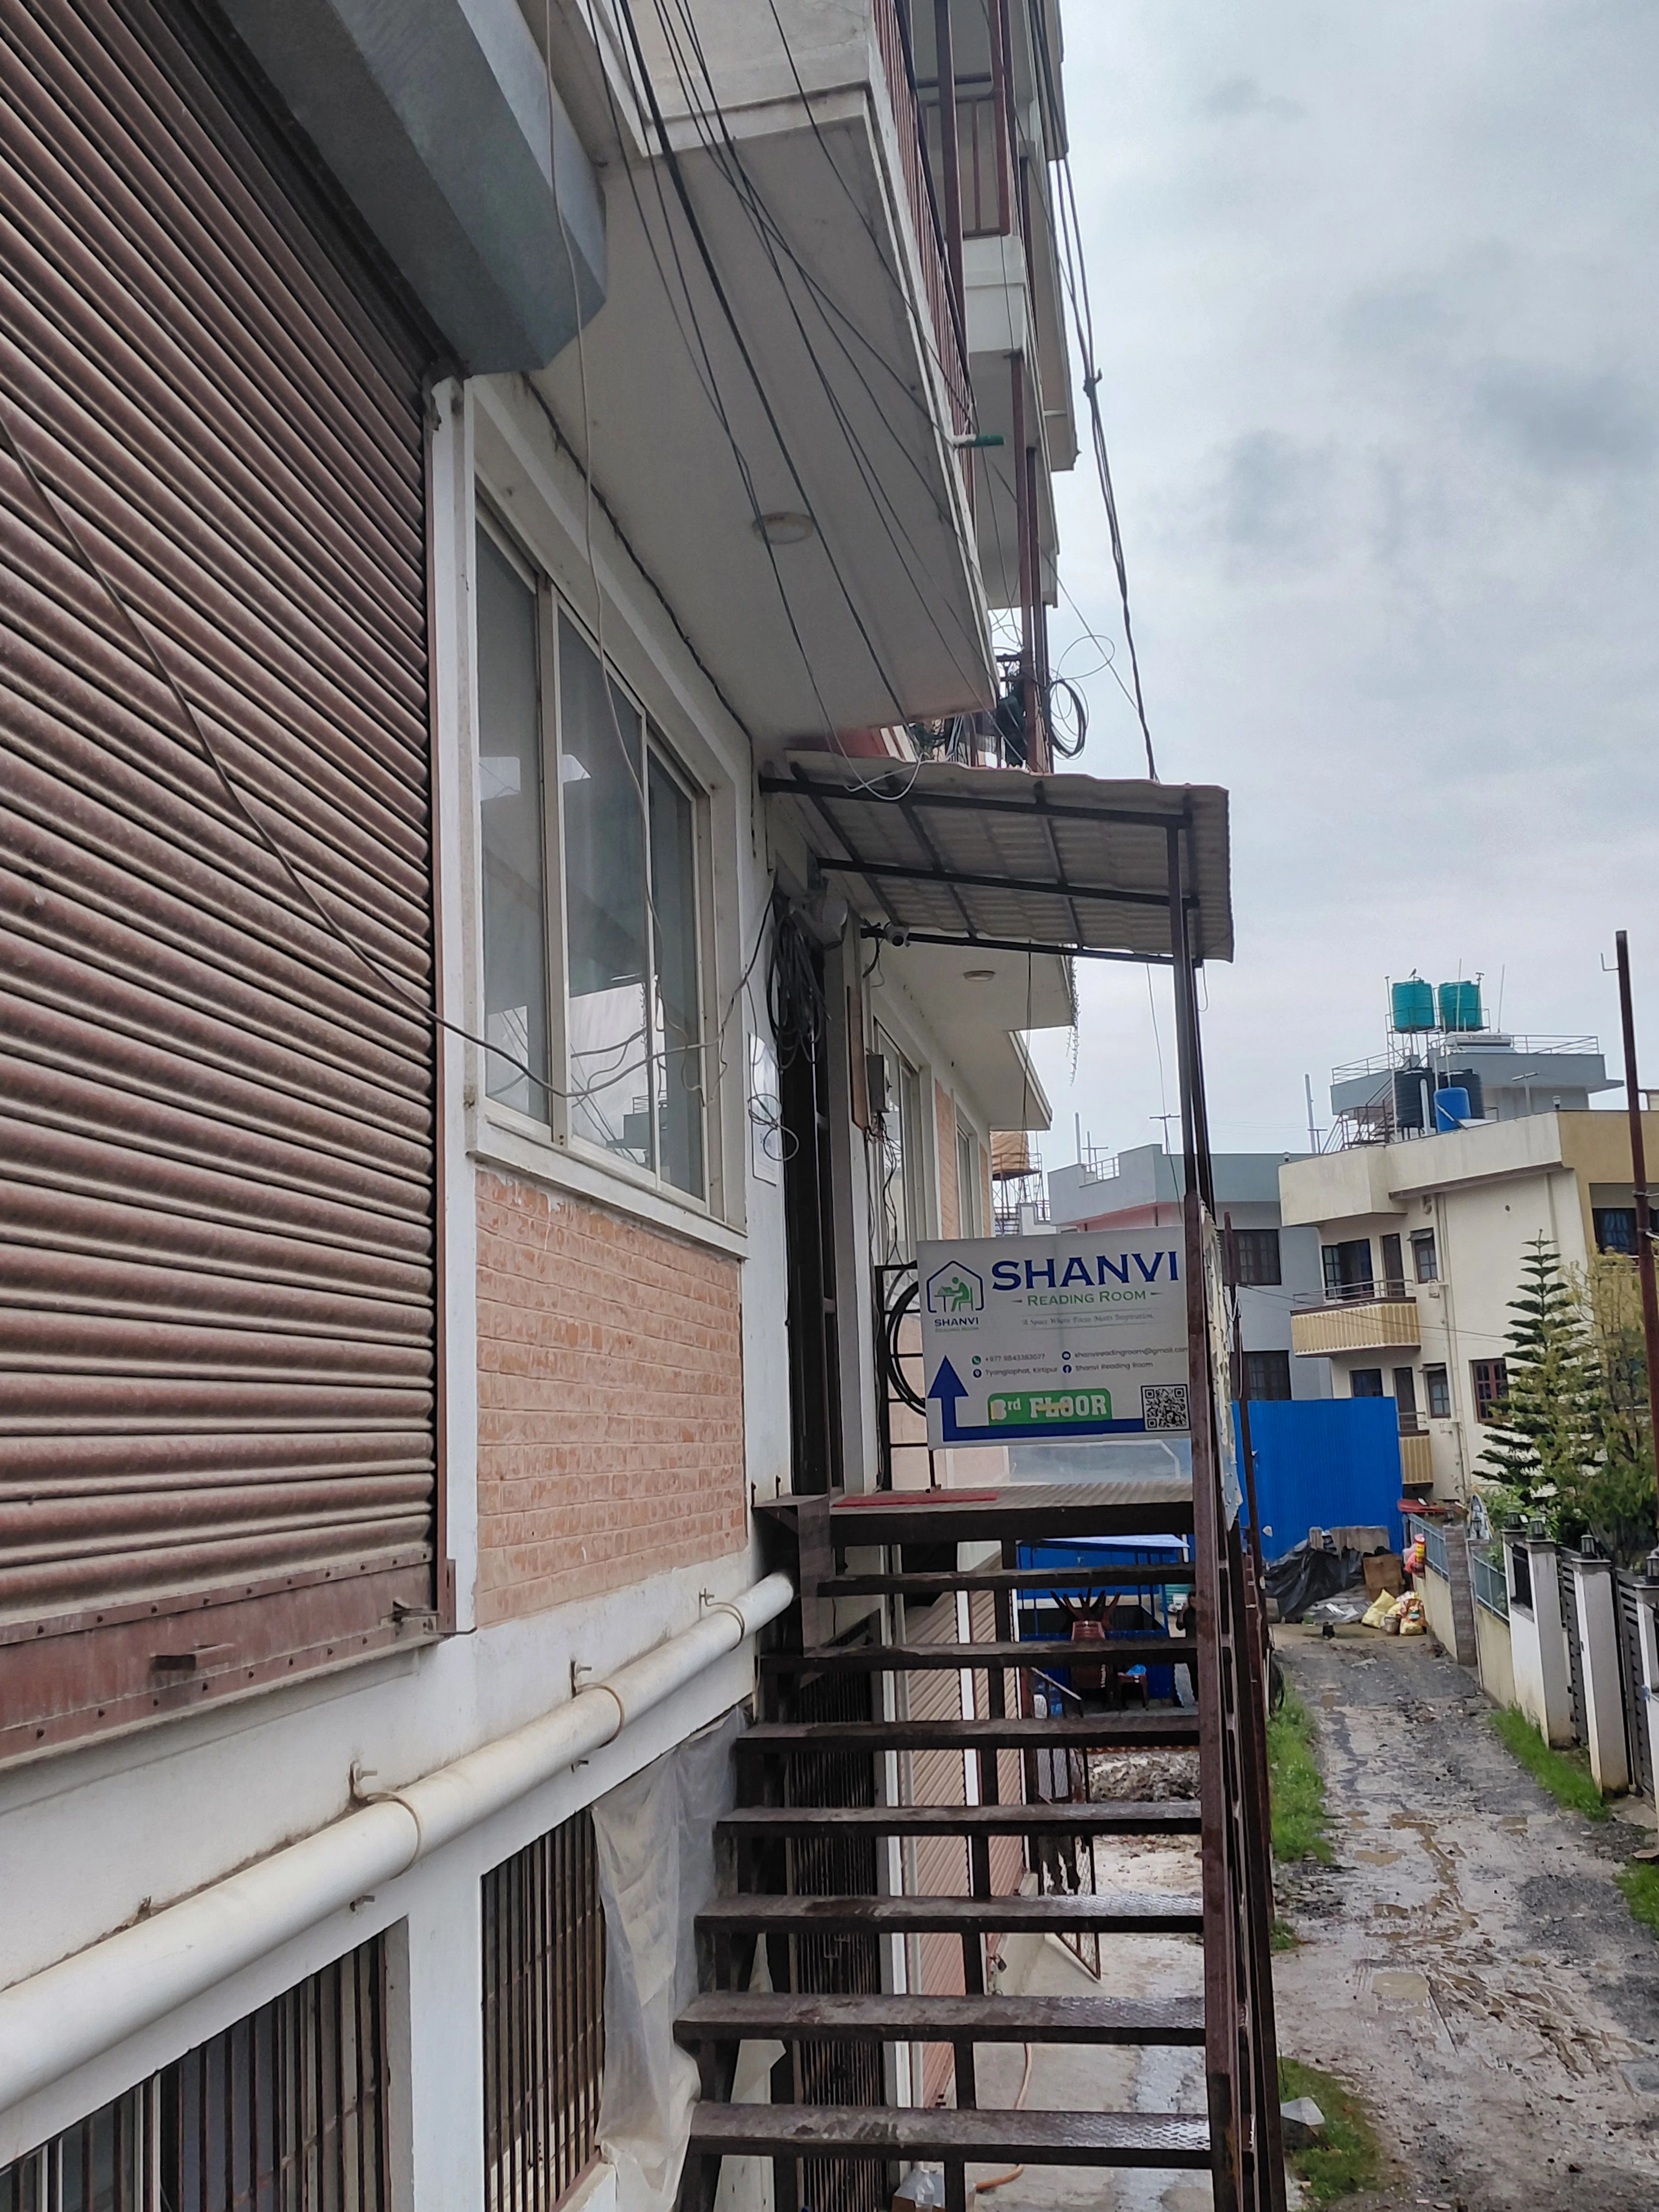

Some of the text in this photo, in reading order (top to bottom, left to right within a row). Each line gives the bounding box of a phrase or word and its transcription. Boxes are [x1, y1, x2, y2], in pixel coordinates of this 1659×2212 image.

[991, 1251, 1179, 1291] SHANVI
[1027, 1290, 1146, 1306] READING ROOM
[934, 1316, 979, 1327] SHANVI
[990, 1394, 1107, 1420] 3rd FLOOR
